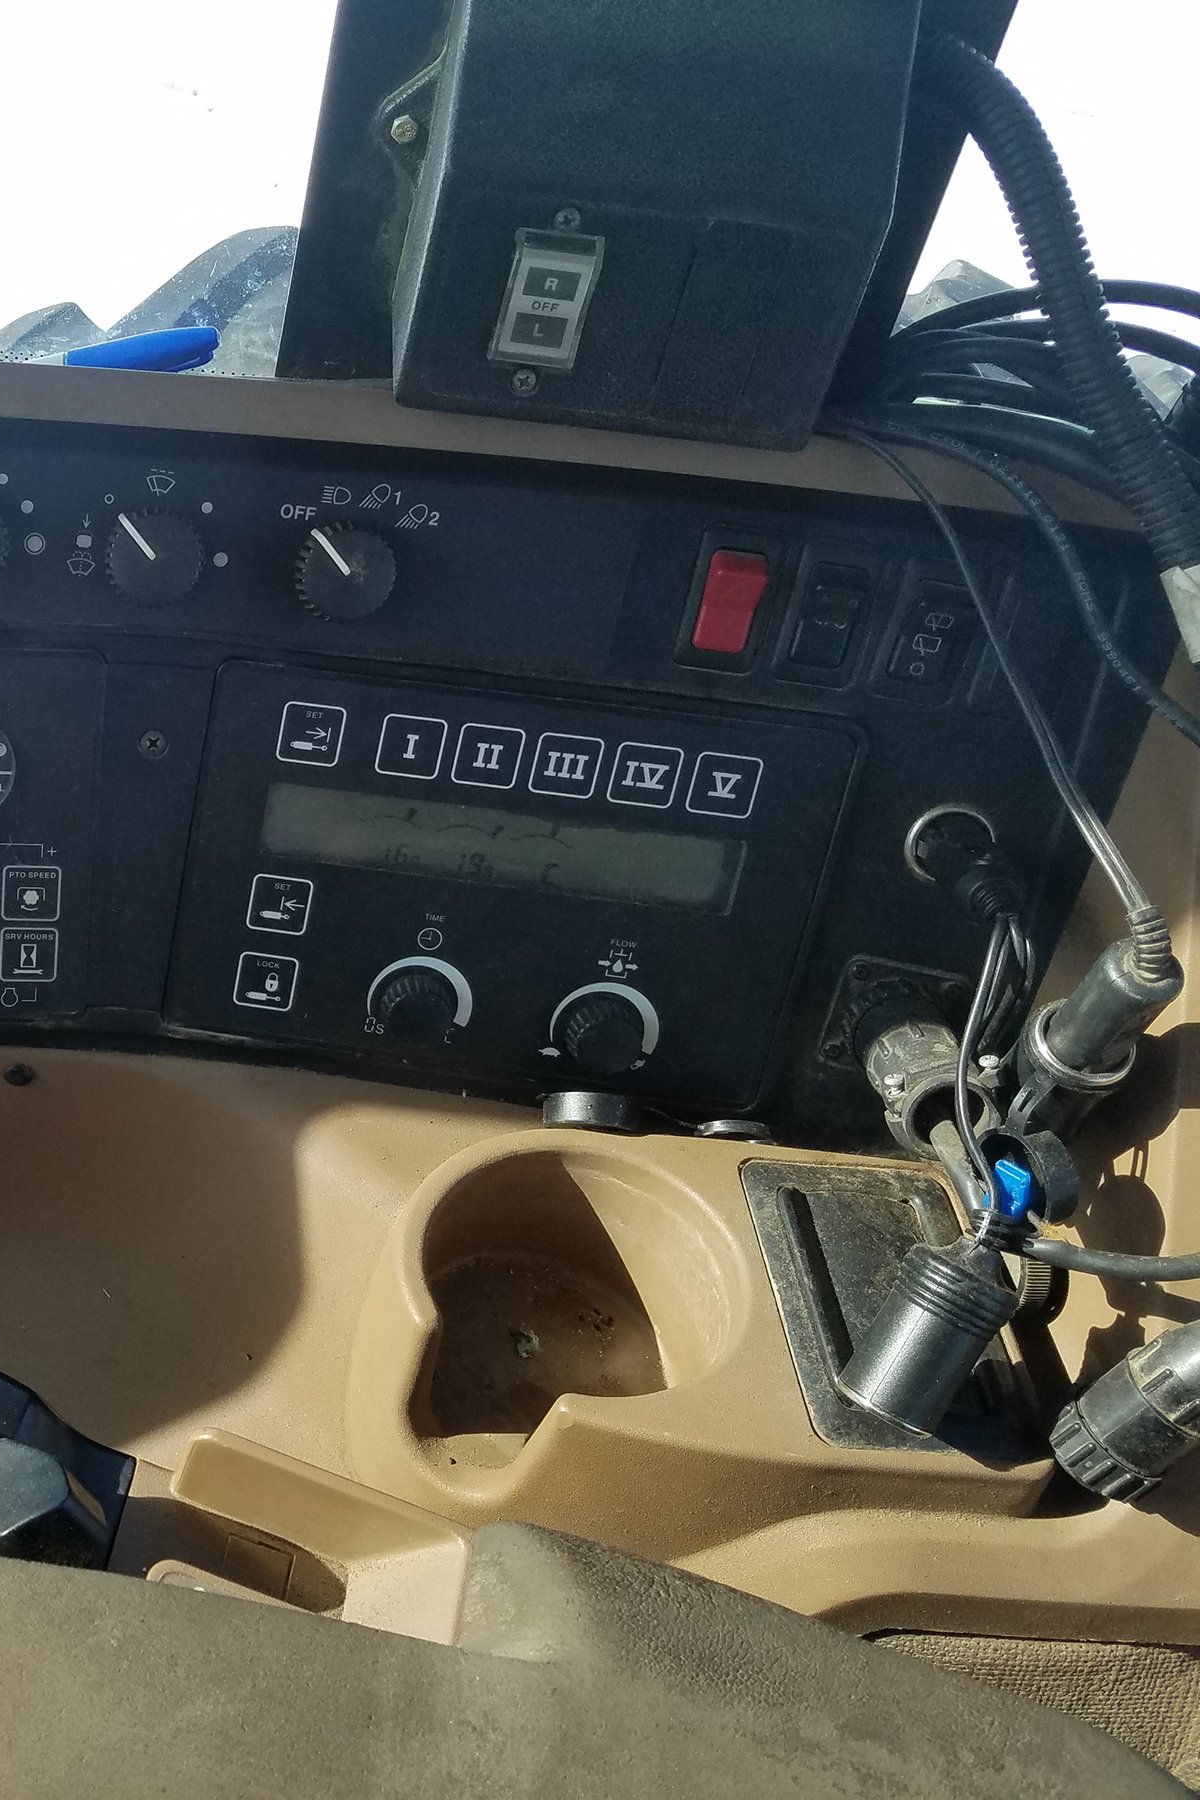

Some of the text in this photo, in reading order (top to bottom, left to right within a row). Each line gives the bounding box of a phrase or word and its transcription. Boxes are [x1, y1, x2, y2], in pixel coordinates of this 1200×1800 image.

[544, 277, 559, 291] R
[531, 300, 560, 313] OFF
[532, 323, 543, 337] L
[394, 490, 402, 506] 1
[280, 503, 317, 521] OFF
[428, 511, 440, 526] 2
[305, 710, 325, 720] SET
[402, 734, 741, 799] I II III IV V
[9, 871, 26, 879] PTO
[274, 882, 292, 892] SET
[425, 913, 446, 923] TIME
[23, 933, 55, 941] HOURS
[610, 939, 638, 949] FLOW
[256, 960, 281, 970] LOCK
